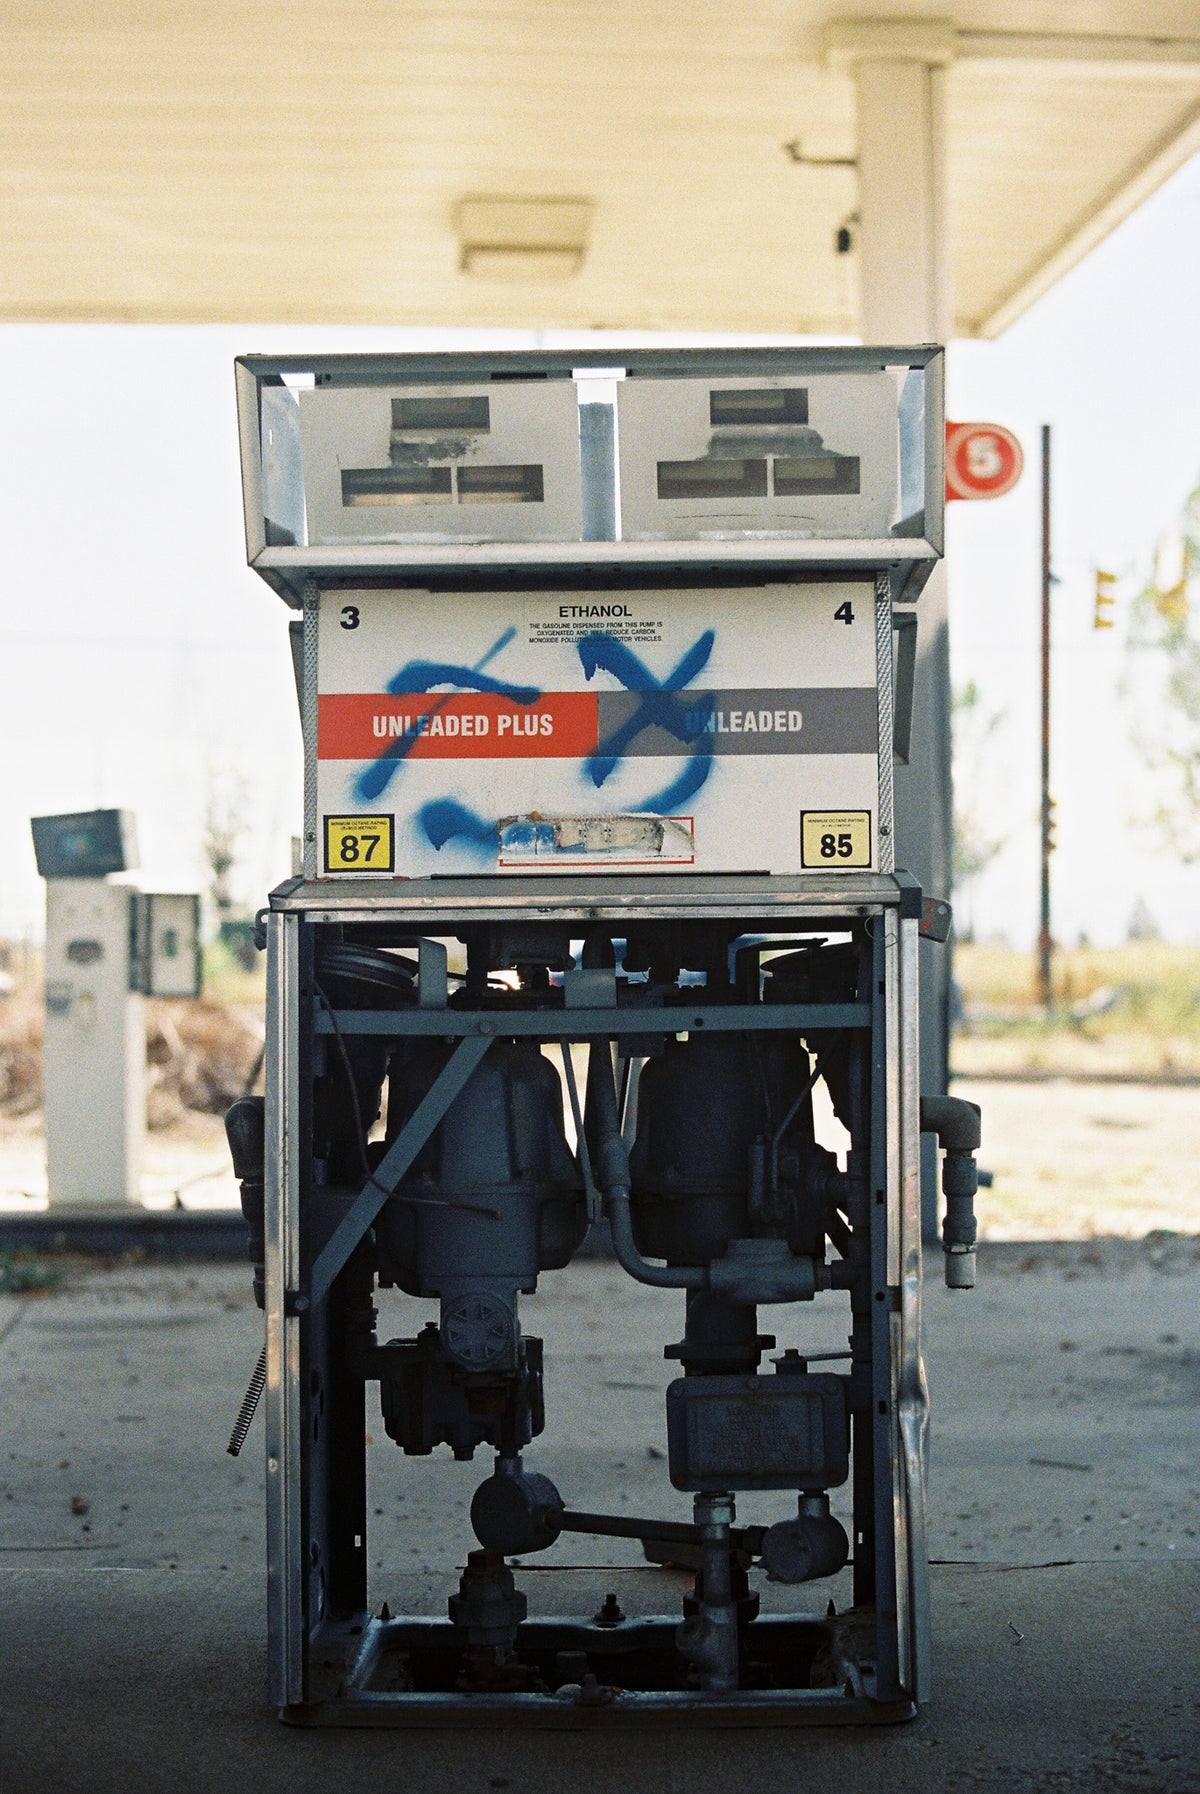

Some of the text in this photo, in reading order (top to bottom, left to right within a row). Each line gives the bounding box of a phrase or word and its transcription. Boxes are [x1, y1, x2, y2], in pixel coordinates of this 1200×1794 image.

[339, 605, 361, 630] 3
[559, 605, 632, 618] ETHANOL
[833, 601, 855, 625] 4
[372, 714, 554, 737] UNLEADED PLUS
[685, 710, 803, 733] UNLEADED
[340, 834, 381, 863] 87
[820, 833, 853, 858] 85
